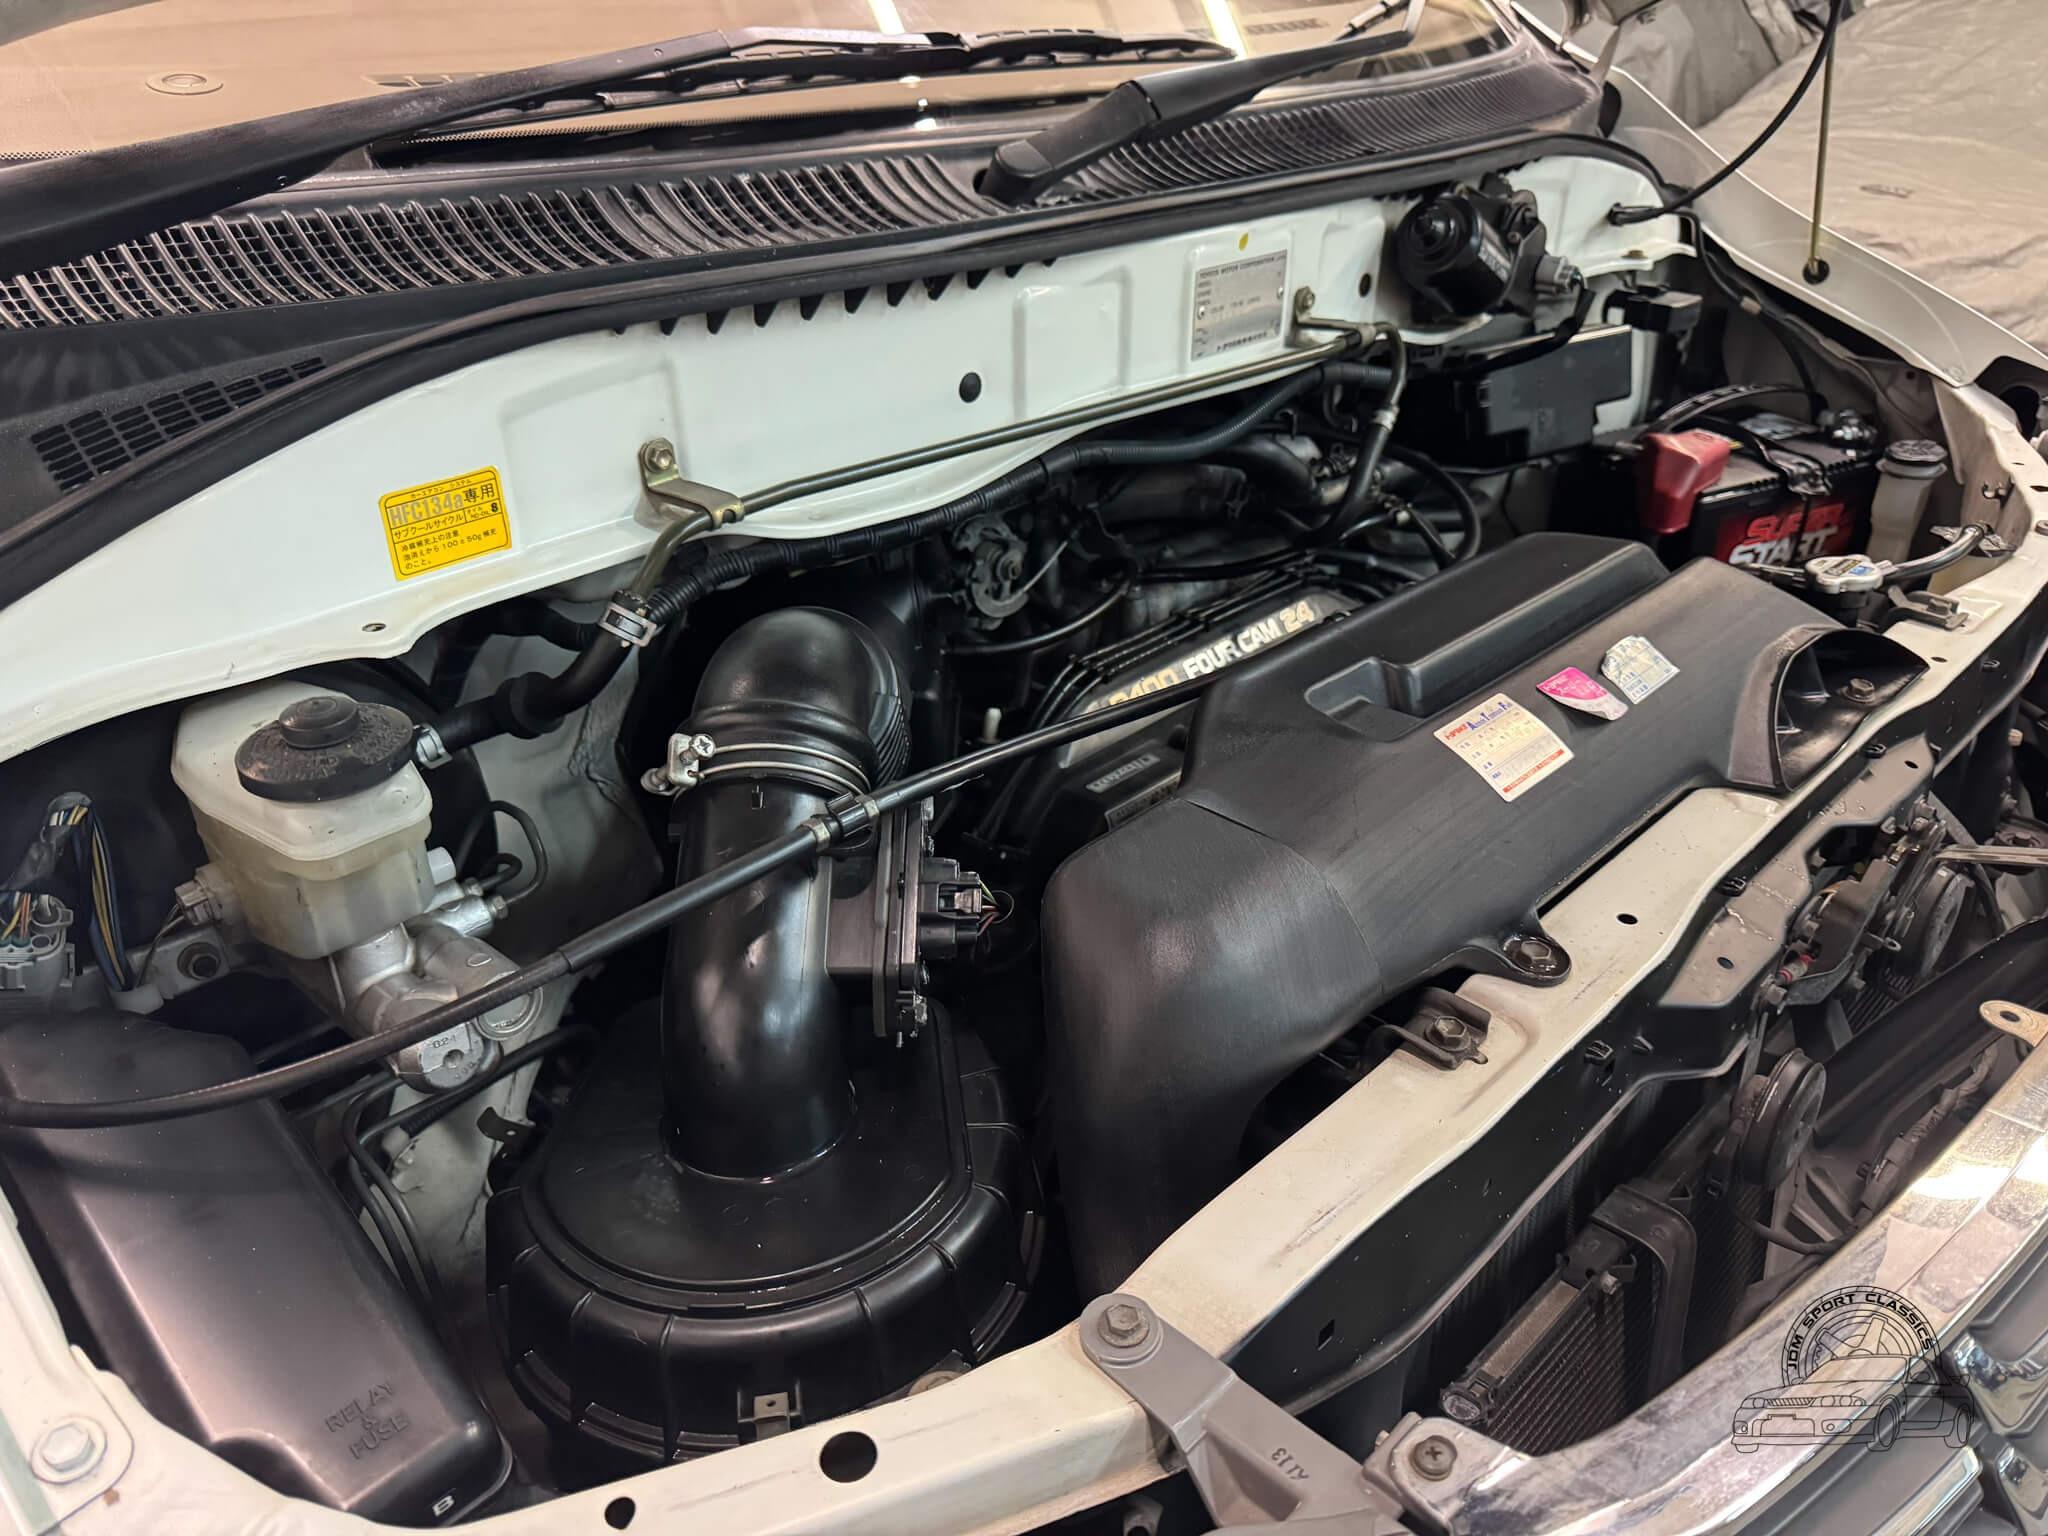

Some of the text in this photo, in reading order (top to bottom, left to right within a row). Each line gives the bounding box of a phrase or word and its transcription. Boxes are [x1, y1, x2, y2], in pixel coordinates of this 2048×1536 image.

[394, 514, 464, 540] サブクールサイクル
[1183, 637, 1241, 679] FOUR
[1237, 619, 1281, 653] CAM
[1279, 600, 1316, 633] 24
[325, 1380, 395, 1432] RELAY
[349, 1410, 410, 1460] FUSE
